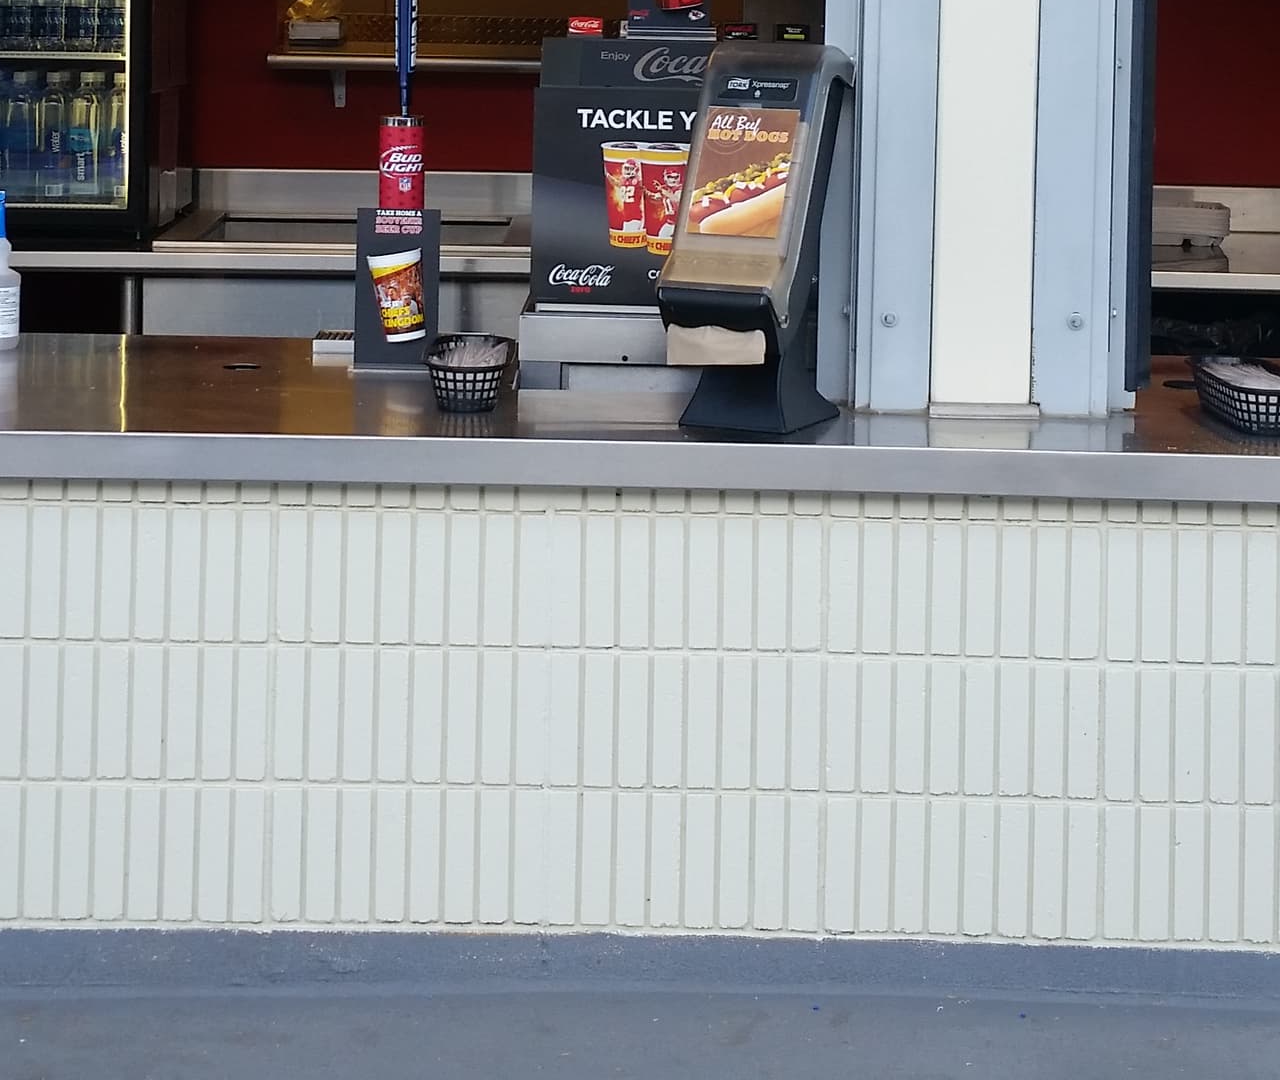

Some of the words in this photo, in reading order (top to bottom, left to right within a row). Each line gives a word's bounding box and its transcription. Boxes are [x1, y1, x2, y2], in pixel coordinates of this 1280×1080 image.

[600, 51, 630, 62] Enjoy
[752, 80, 791, 89] Xpressnap
[577, 108, 673, 130] TACKLE
[712, 115, 734, 129] All
[736, 116, 762, 135] Beef
[707, 129, 742, 141] HOT
[744, 131, 789, 143] DOGS
[389, 152, 422, 163] BUD
[383, 162, 424, 172] LIGHT
[549, 264, 616, 287] Coca-Cola
